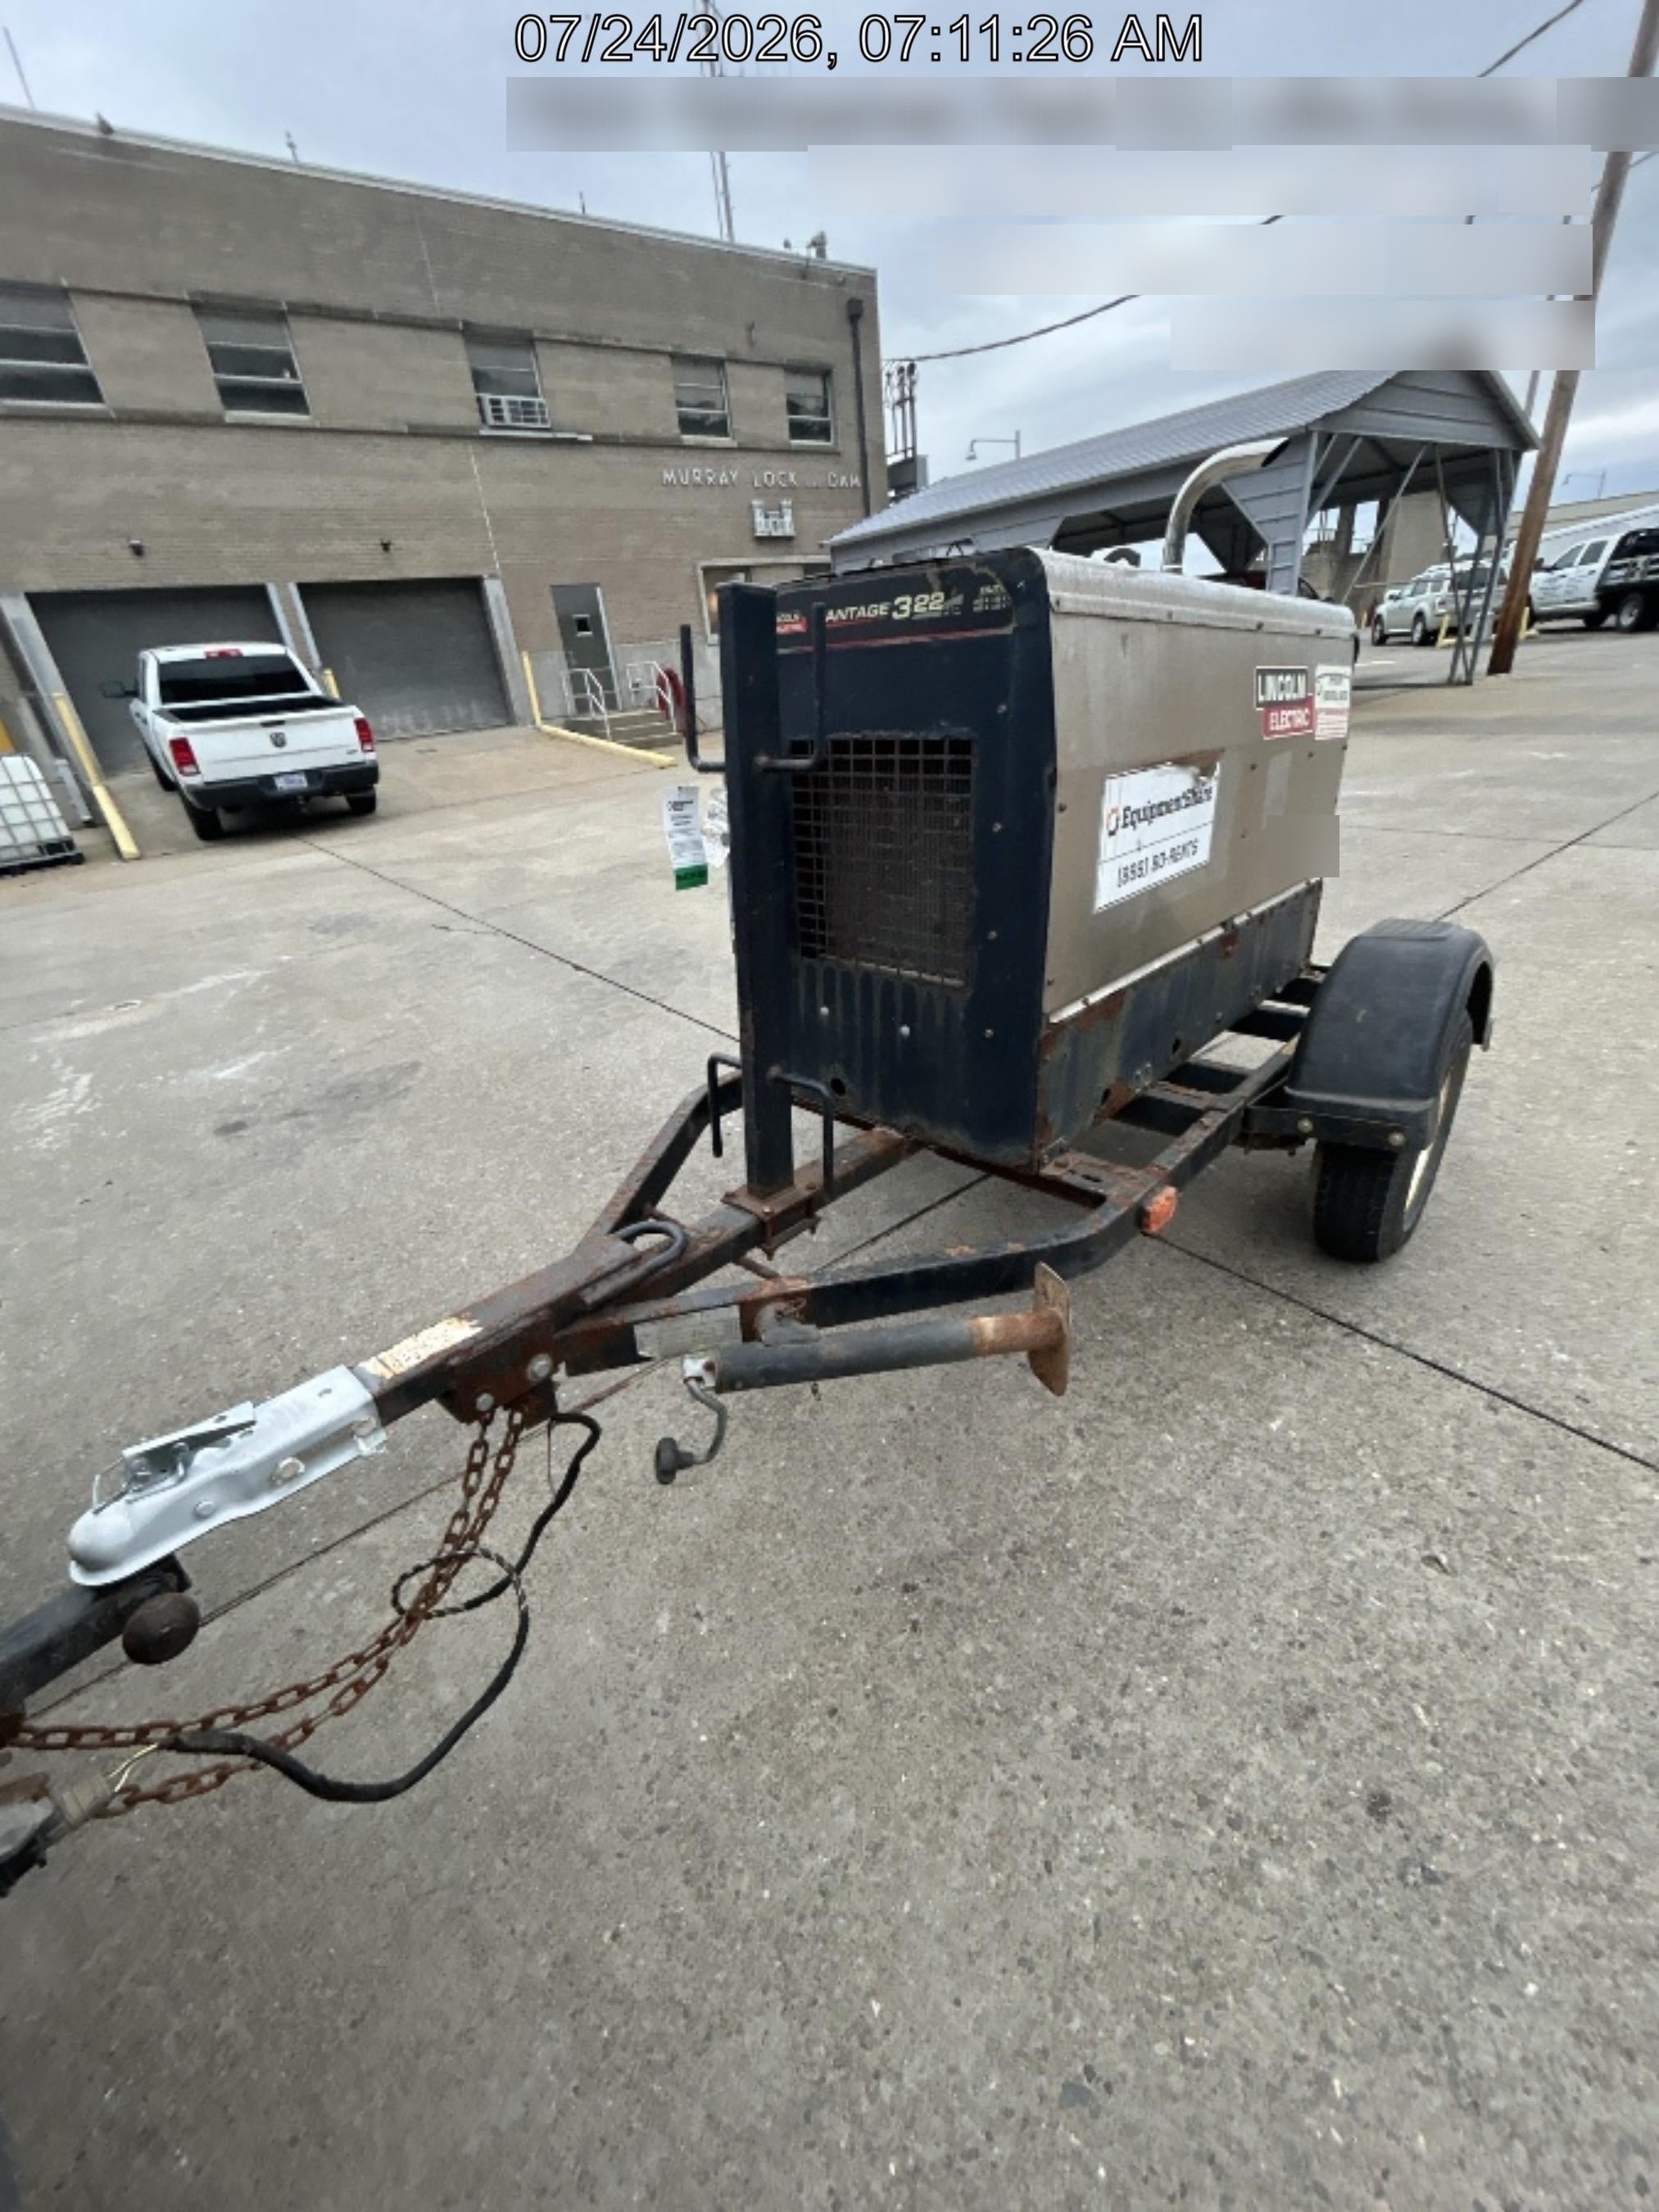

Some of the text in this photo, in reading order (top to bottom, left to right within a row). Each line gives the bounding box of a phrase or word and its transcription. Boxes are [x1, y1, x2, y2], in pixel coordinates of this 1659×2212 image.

[662, 468, 738, 487] MURRAY
[752, 471, 798, 489] LOCK
[825, 601, 891, 623] ANTAGE
[891, 591, 945, 620] 322
[1258, 673, 1307, 703] LINCOLN
[1270, 707, 1310, 731] ELECTRIC
